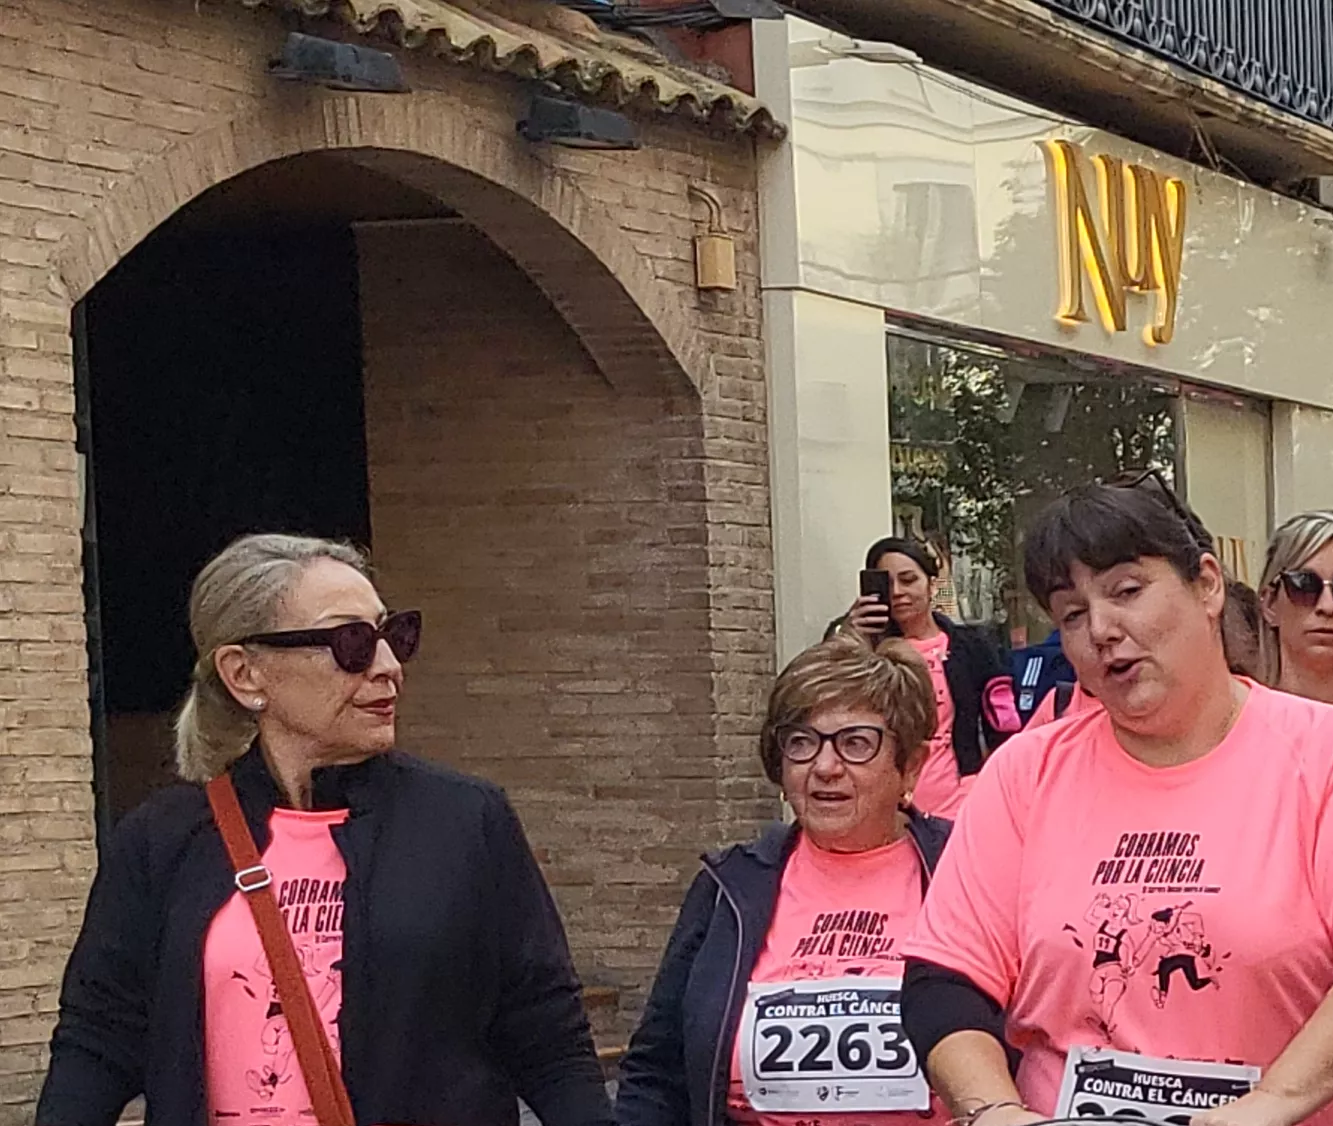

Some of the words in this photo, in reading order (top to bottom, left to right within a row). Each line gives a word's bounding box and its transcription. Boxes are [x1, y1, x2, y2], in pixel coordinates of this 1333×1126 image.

[1113, 831, 1201, 858] CORRAMOS
[1091, 860, 1126, 886] POR
[1123, 859, 1145, 884] LA
[1144, 858, 1206, 884] CIENCIA
[291, 904, 310, 934] LA
[818, 932, 837, 956] LA
[764, 1004, 827, 1018] CONTRA
[829, 1003, 846, 1015] EL
[849, 1000, 901, 1015] CÁNCE
[816, 991, 859, 1004] HUESCA
[759, 1022, 911, 1073] 2263
[1083, 1078, 1144, 1101] CONTRA
[1147, 1088, 1168, 1103] EL
[1132, 1072, 1183, 1089] HUESCA
